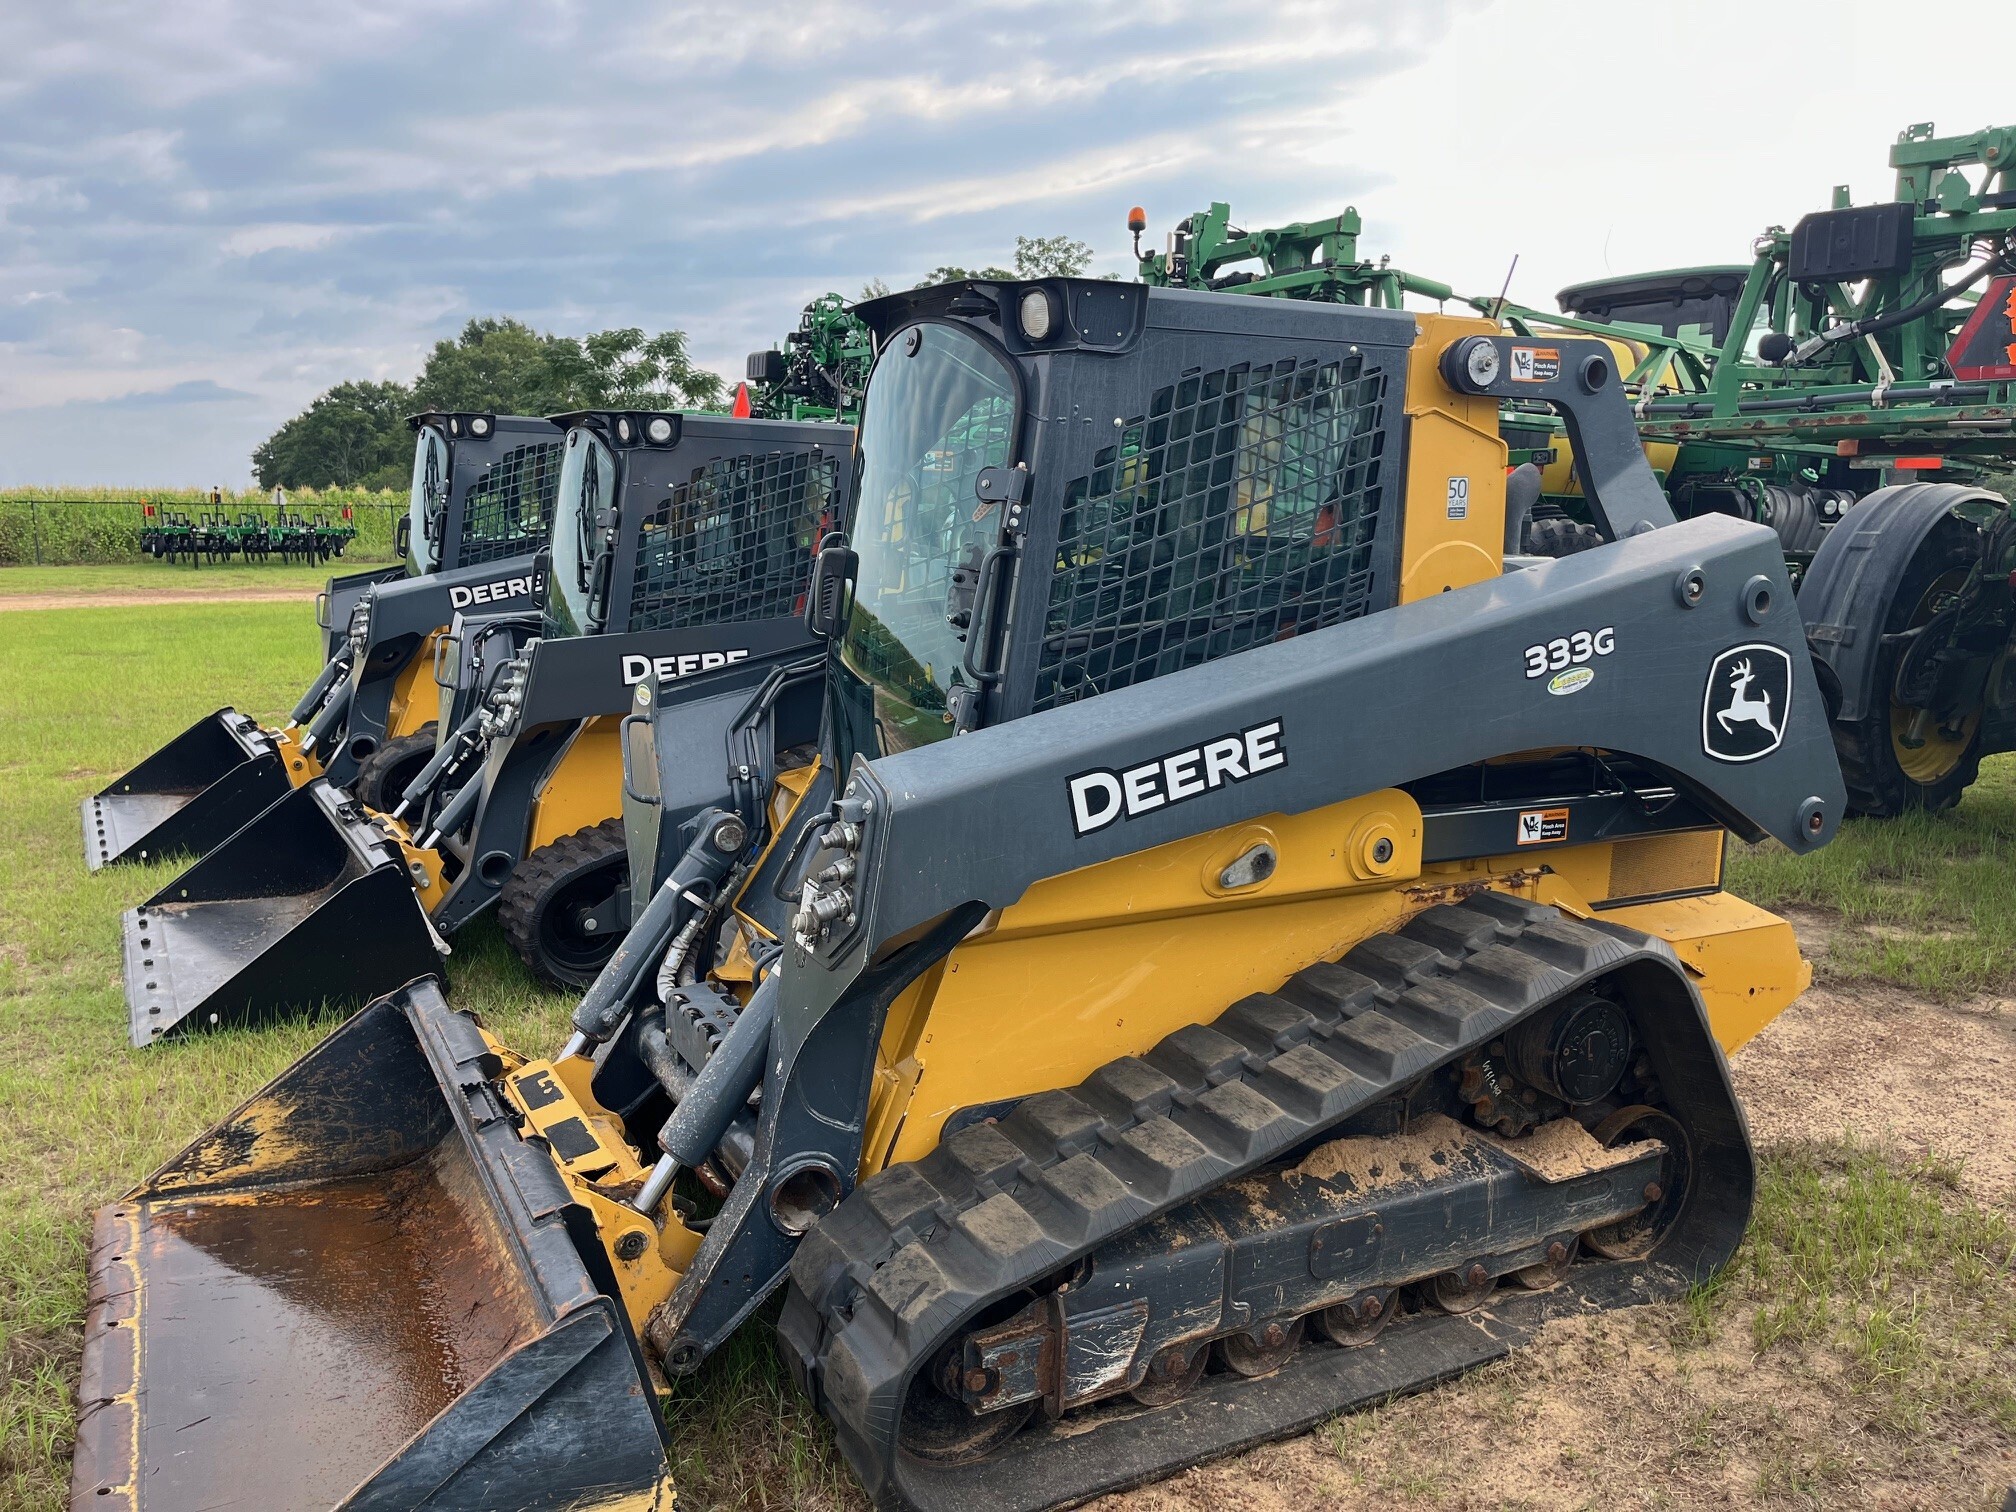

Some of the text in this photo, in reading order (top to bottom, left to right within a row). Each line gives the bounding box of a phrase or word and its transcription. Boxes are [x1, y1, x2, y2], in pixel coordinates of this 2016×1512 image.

[1449, 479, 1467, 499] 50
[1525, 627, 1615, 678] 333G
[1069, 721, 1286, 834] DEERE
